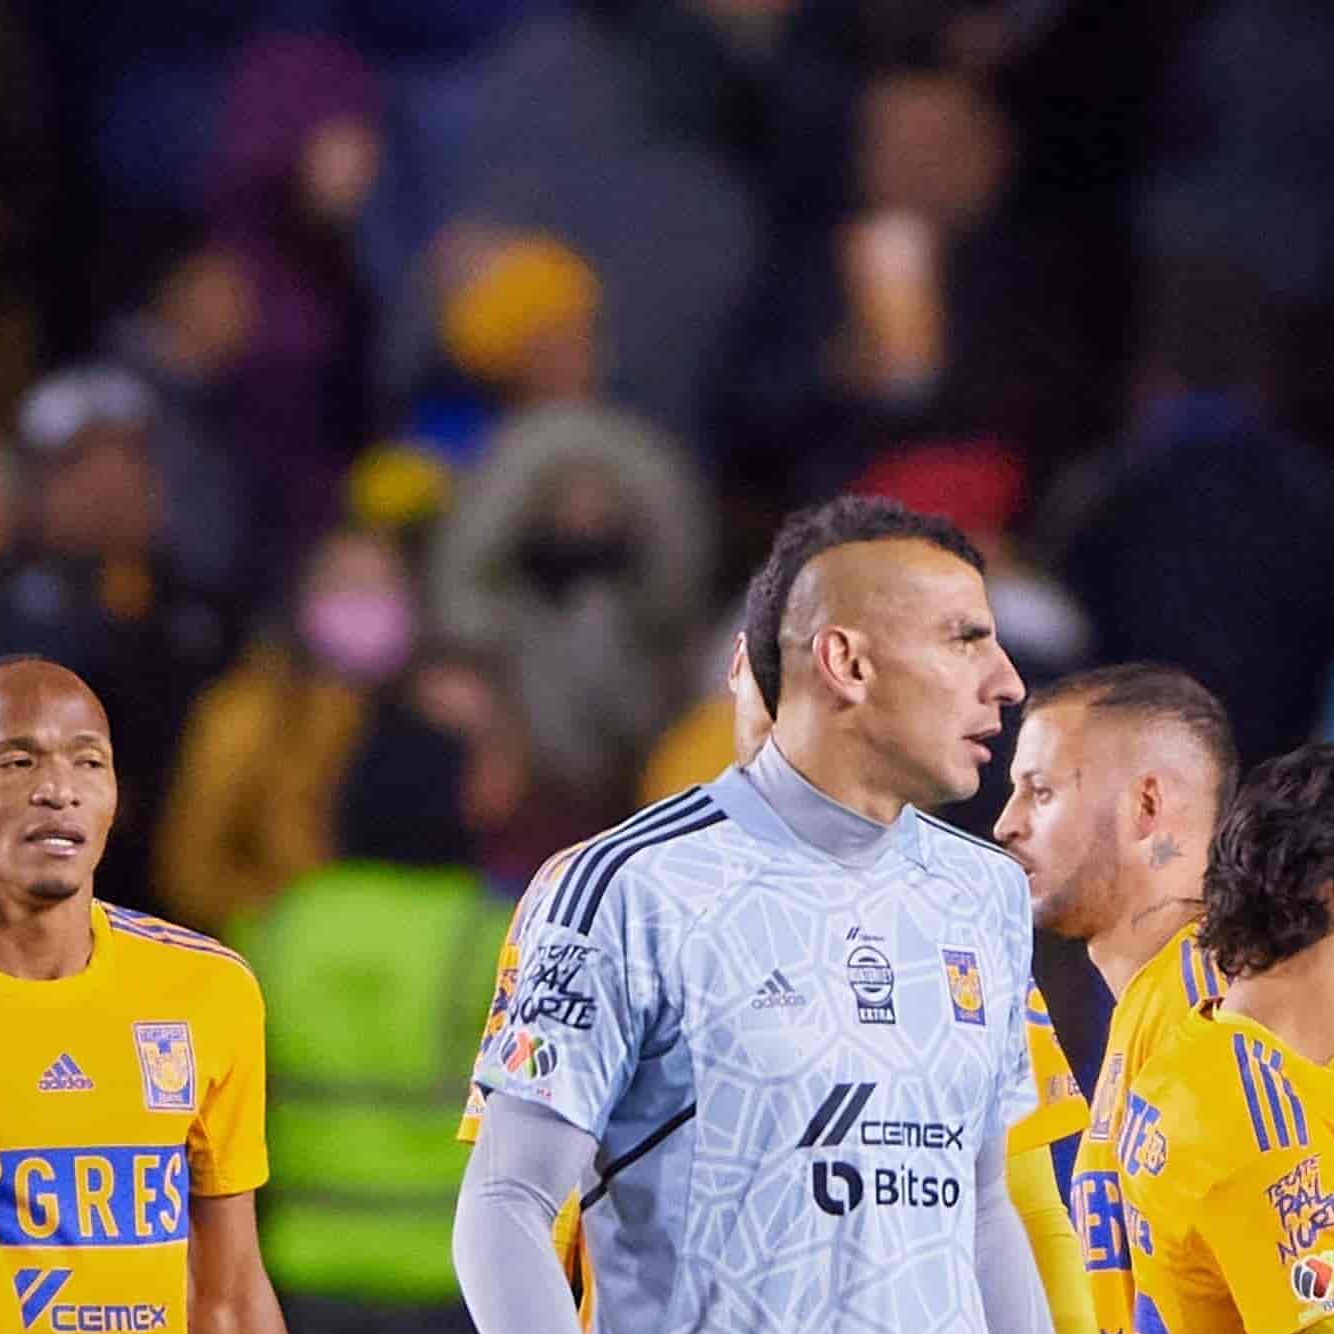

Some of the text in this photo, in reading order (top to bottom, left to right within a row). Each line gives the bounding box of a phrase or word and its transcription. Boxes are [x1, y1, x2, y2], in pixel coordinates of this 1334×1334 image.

[861, 1121, 964, 1150] CEMEX
[13, 1151, 183, 1240] GRES
[875, 1163, 960, 1208] Bitso
[51, 1304, 167, 1332] CEMEX
